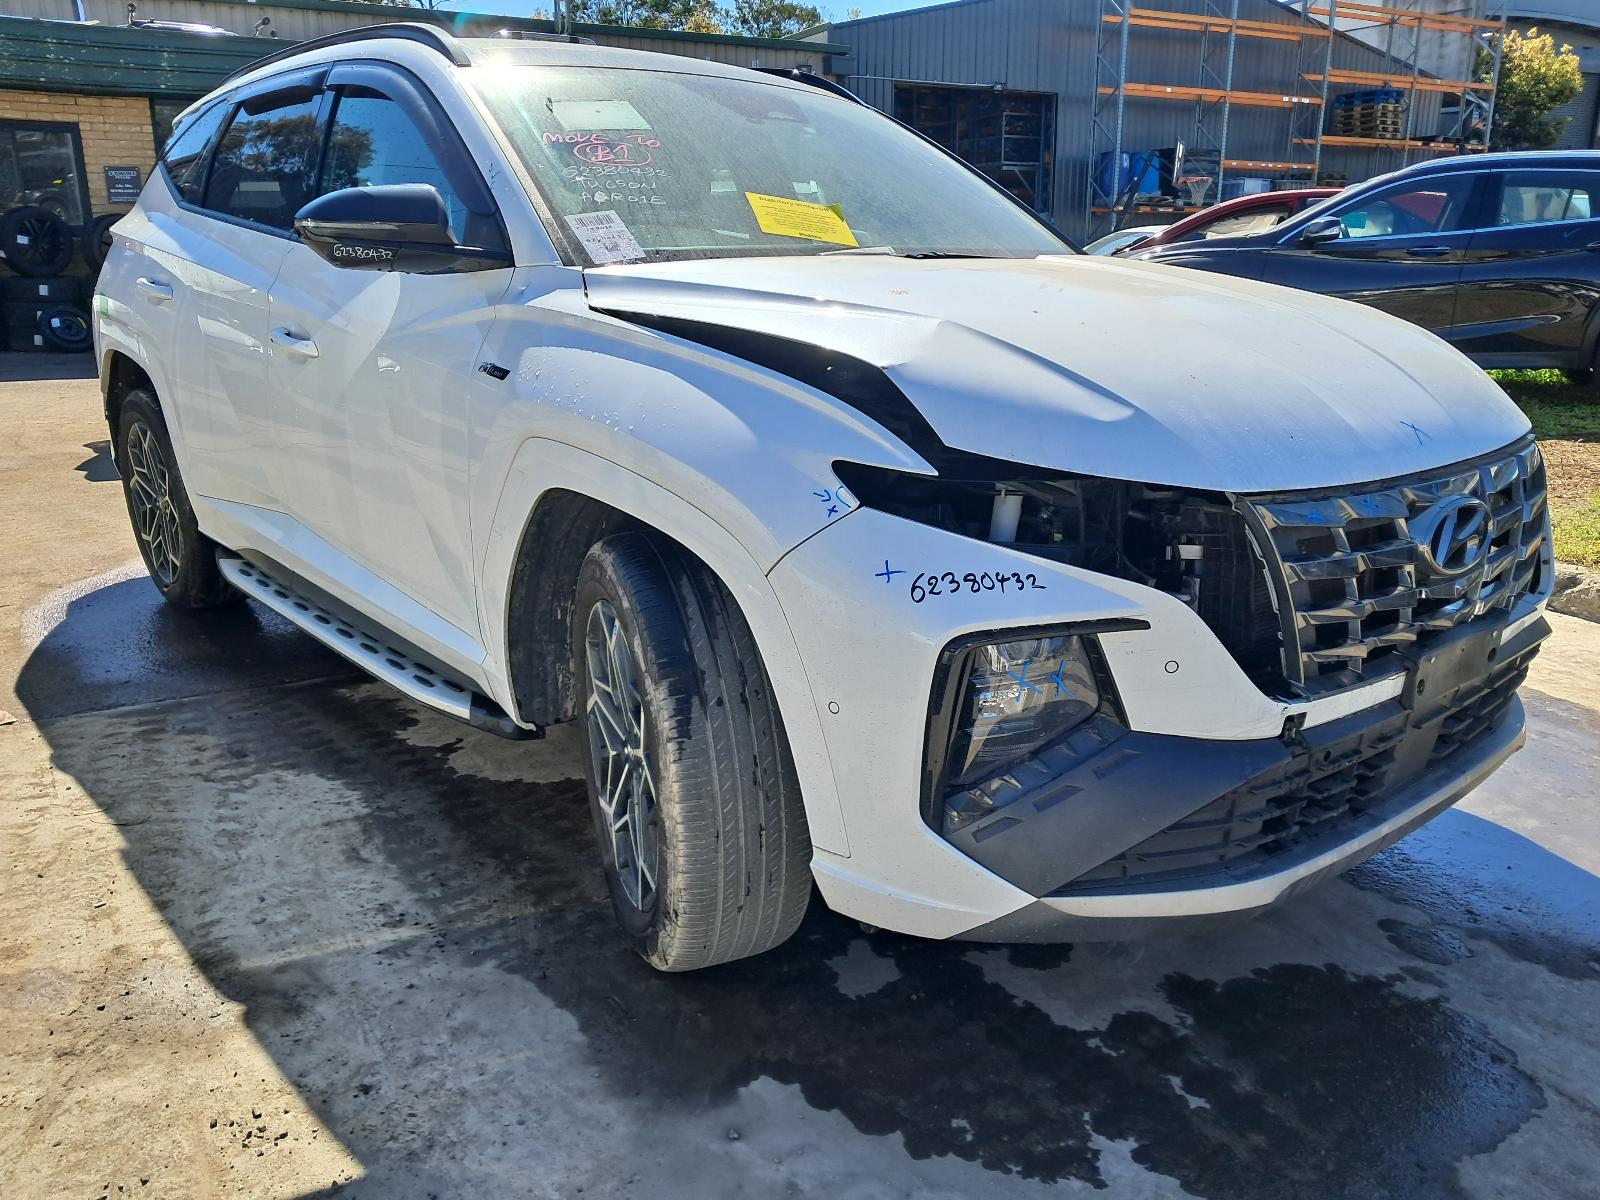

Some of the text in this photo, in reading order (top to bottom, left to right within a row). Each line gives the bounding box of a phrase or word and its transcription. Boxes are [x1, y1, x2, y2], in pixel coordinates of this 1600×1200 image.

[586, 144, 635, 162] B1
[563, 166, 668, 178] 62380432
[570, 176, 657, 189] TUCSON
[334, 244, 393, 261] 62380432
[910, 571, 1048, 604] 62380432
